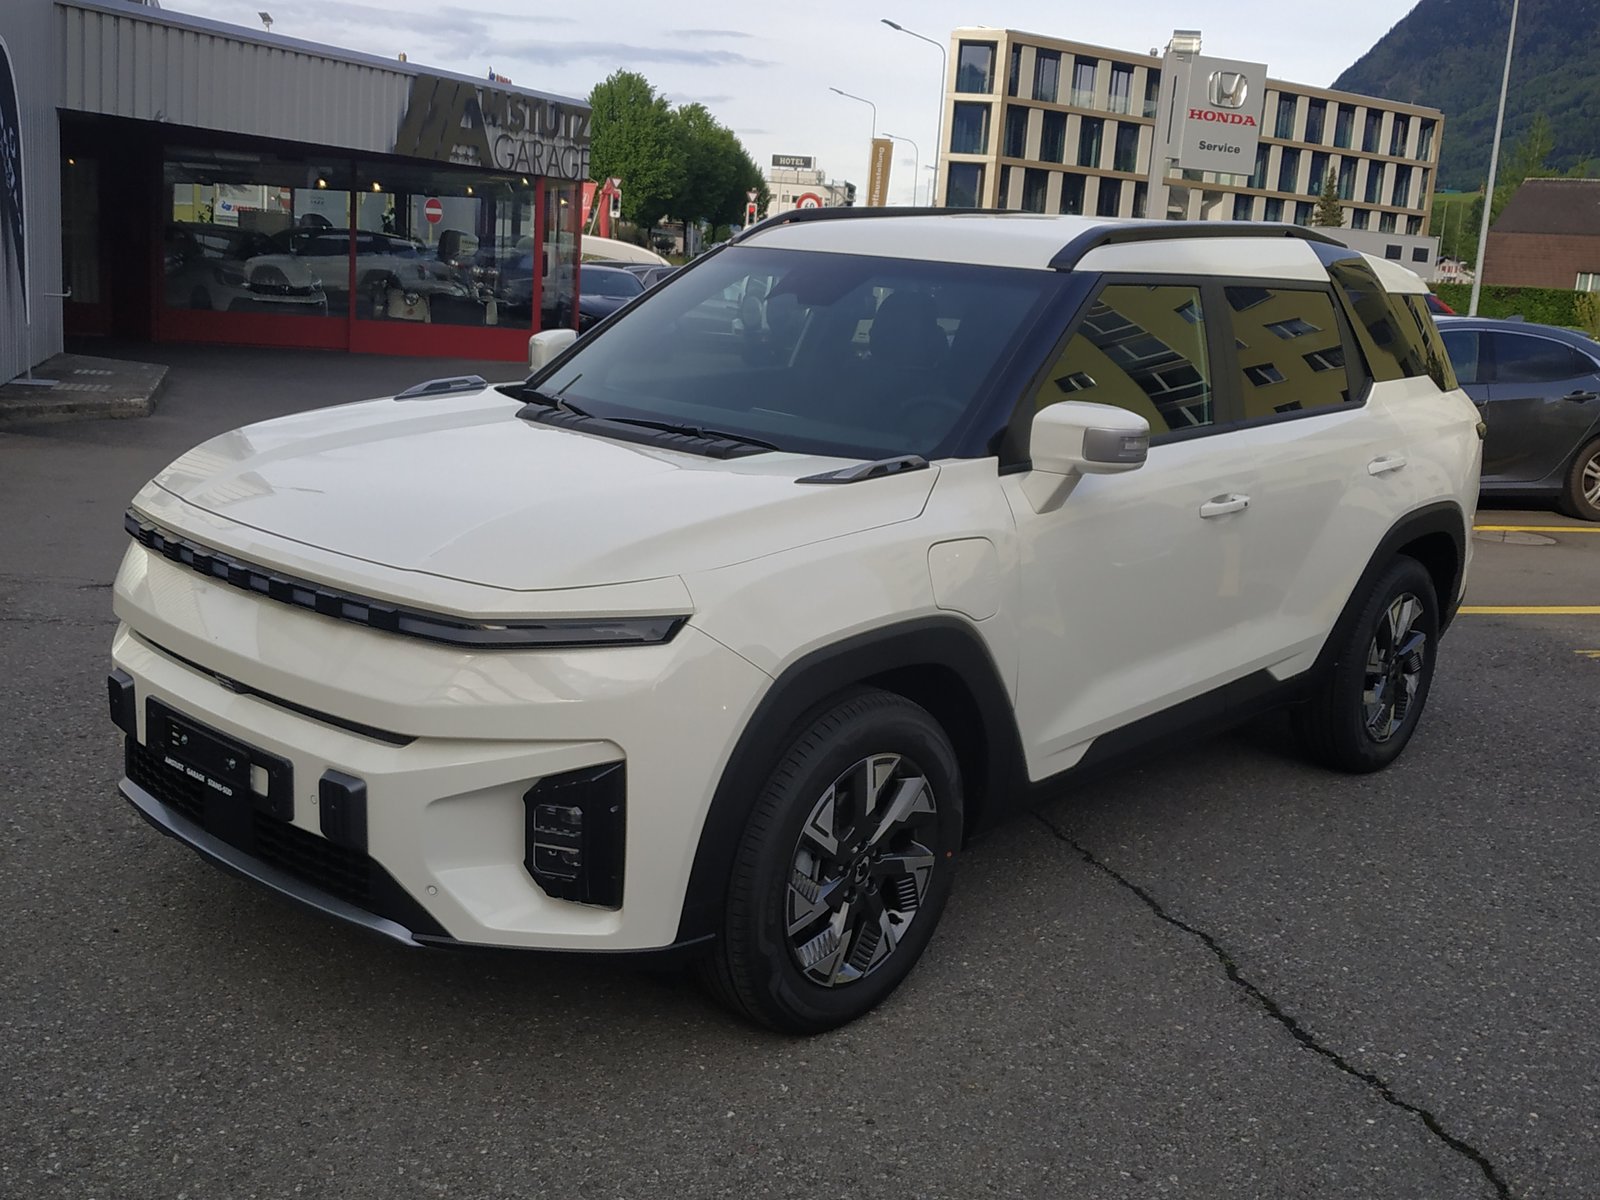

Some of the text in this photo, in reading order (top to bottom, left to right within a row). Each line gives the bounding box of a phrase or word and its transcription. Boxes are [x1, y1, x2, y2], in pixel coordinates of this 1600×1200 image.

[436, 79, 592, 168] AMSTUTZ
[1188, 109, 1257, 127] HONDA
[1198, 140, 1241, 154] Service
[494, 133, 591, 181] GARAGE
[779, 157, 805, 166] HOTEL
